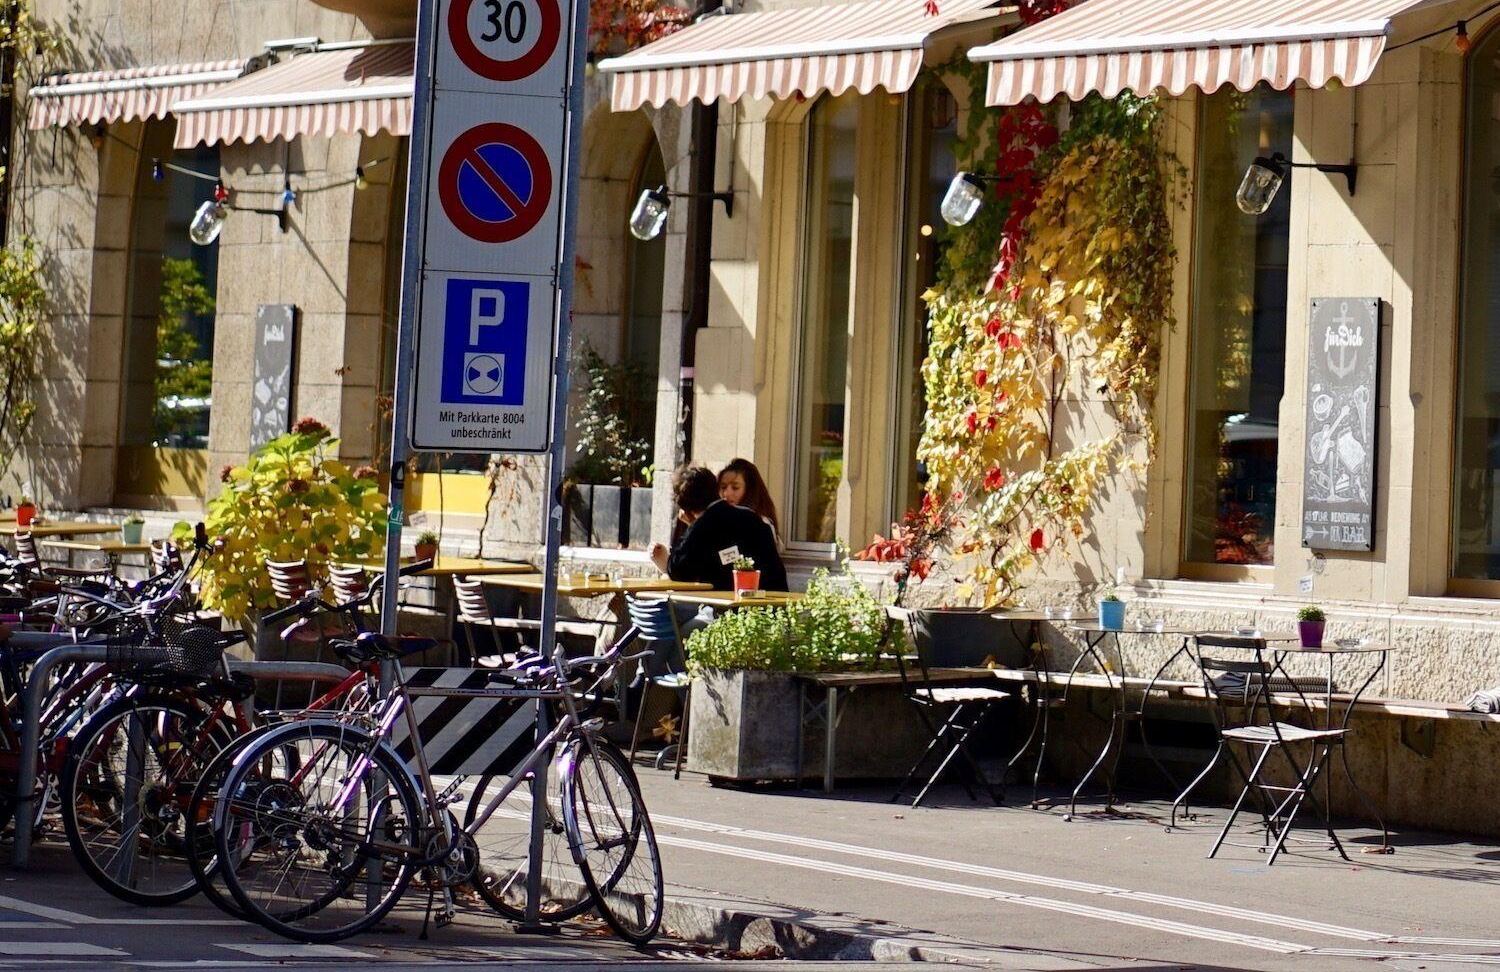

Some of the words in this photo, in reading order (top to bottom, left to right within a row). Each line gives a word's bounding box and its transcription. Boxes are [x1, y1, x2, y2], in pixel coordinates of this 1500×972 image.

[468, 287, 506, 346] P
[439, 411, 455, 423] Mit
[457, 411, 500, 424] Parkkarte
[502, 412, 525, 424] 8004
[451, 426, 512, 439] unbeschränkt
